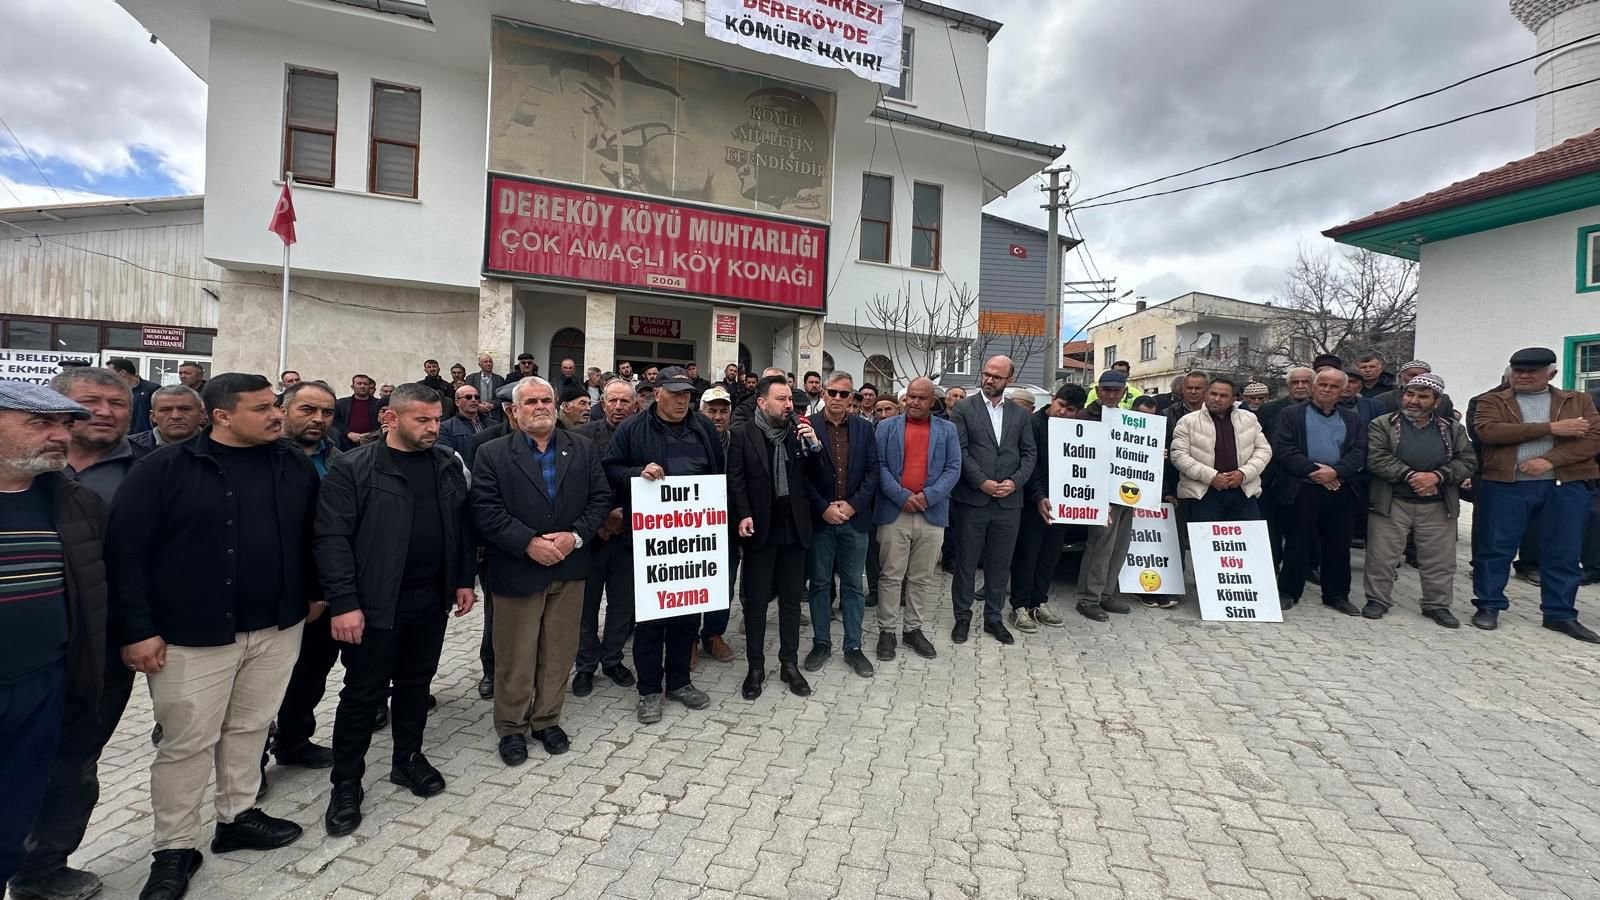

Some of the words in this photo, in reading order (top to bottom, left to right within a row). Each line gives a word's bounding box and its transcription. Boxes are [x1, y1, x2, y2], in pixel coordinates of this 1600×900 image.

[816, 0, 883, 24] RKEZİ
[725, 14, 813, 52] KÖMÜRE
[817, 41, 882, 72] HAYIR!
[751, 106, 803, 128] KÖYLÜ
[739, 125, 814, 152] MİLLETİN
[726, 148, 826, 177] EFENDİSİDİR
[499, 188, 614, 229] DEREKÖY
[620, 204, 681, 239] KÖYÜ
[688, 217, 819, 259] MUHTARLIĞI
[500, 228, 561, 254] ÇOK
[567, 238, 664, 269] AMAÇLI
[672, 250, 722, 274] KÖY
[727, 258, 814, 287] KONAĞI
[651, 276, 681, 286] 2004
[8, 365, 58, 374] EKMEK
[1121, 413, 1147, 429] Yeşil
[1076, 423, 1083, 438] O
[1123, 431, 1145, 446] Arar
[1147, 435, 1158, 448] La
[1063, 443, 1096, 459] Kadın
[1115, 446, 1149, 464] Kömür
[1072, 464, 1087, 479] Bu
[660, 485, 690, 502] Dur
[1063, 484, 1095, 500] Ocağı
[632, 508, 727, 531] Dereköy'ün
[1058, 504, 1099, 520] Kapatır
[1212, 524, 1242, 536] Dere
[645, 533, 717, 557] Kaderini
[1212, 540, 1247, 552] Bizim
[1127, 553, 1169, 568] Beyler
[1220, 556, 1244, 569] Köy
[646, 560, 718, 584] Kömürle
[1217, 572, 1252, 584] Bizim
[657, 588, 709, 609] Yazma
[1216, 588, 1258, 602] Kömür
[1225, 606, 1256, 618] Sizin
